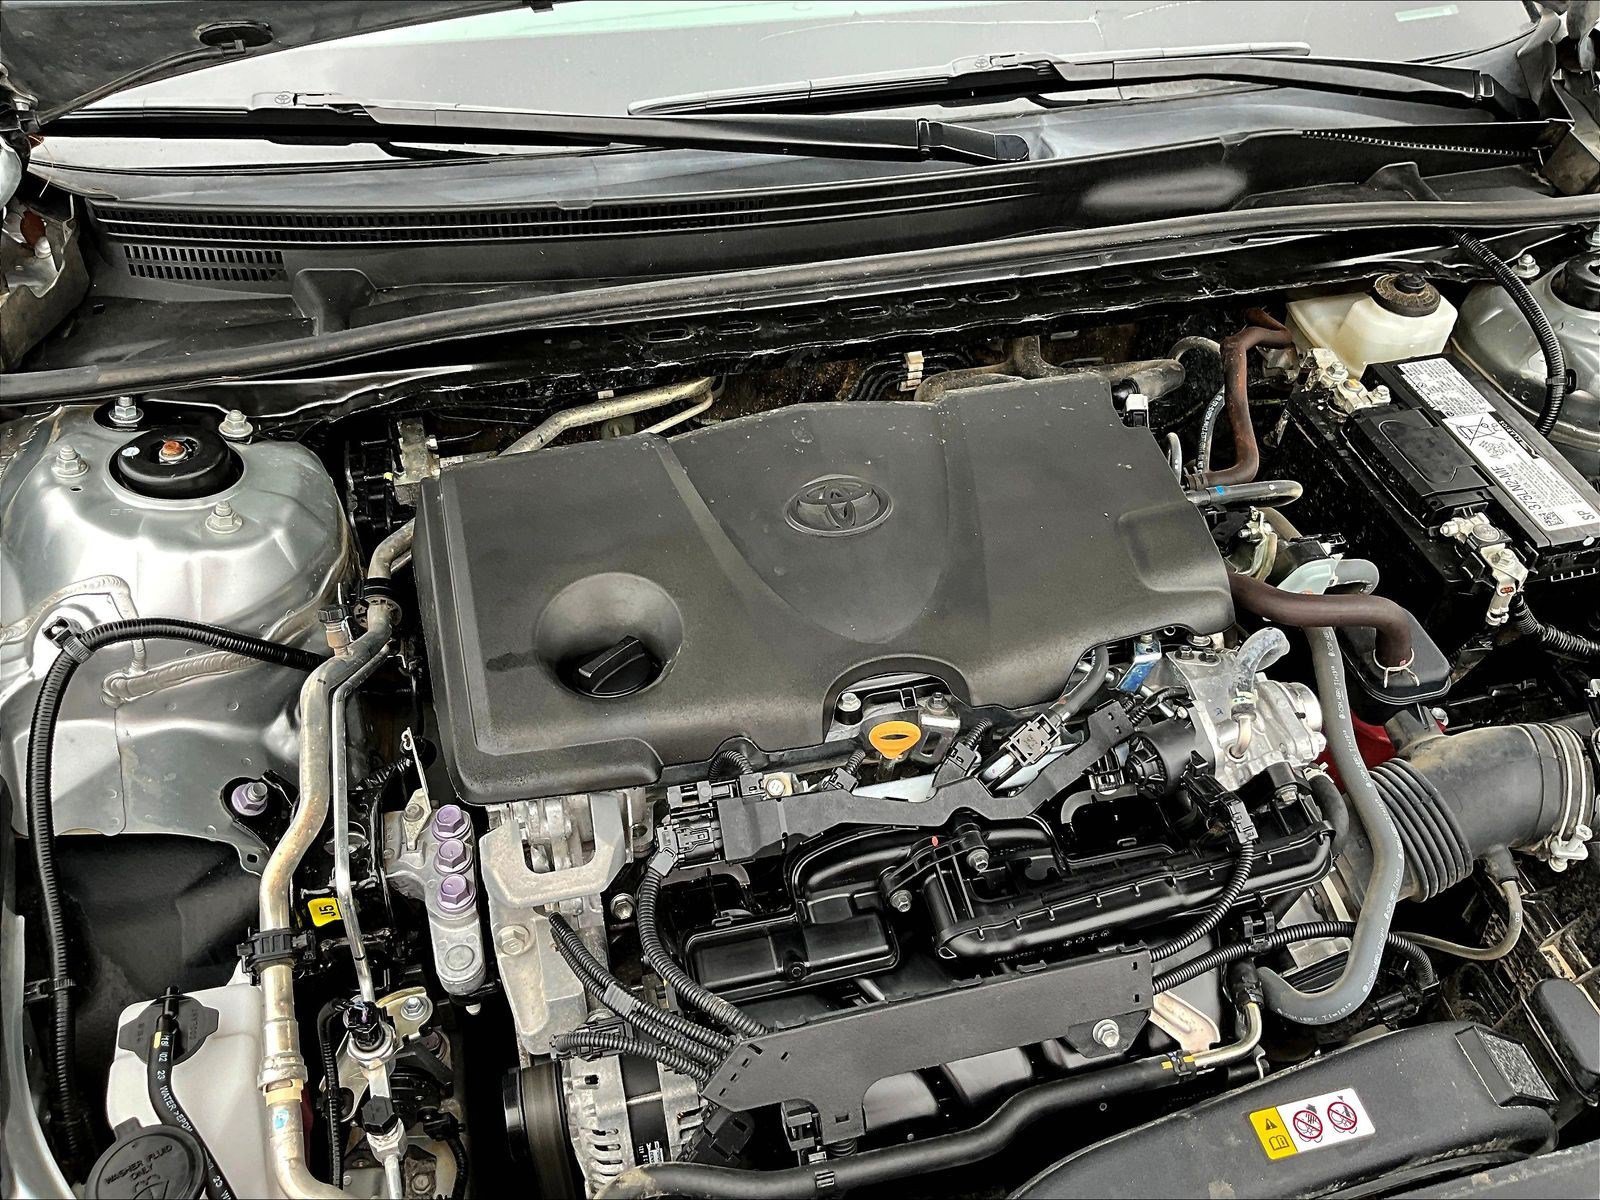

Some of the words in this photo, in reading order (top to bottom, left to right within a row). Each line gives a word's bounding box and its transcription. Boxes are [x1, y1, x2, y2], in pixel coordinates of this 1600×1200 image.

[319, 905, 336, 917] J5
[160, 1085, 177, 1111] WATER
[105, 1160, 143, 1185] WASHER
[146, 1145, 173, 1162] FLUID
